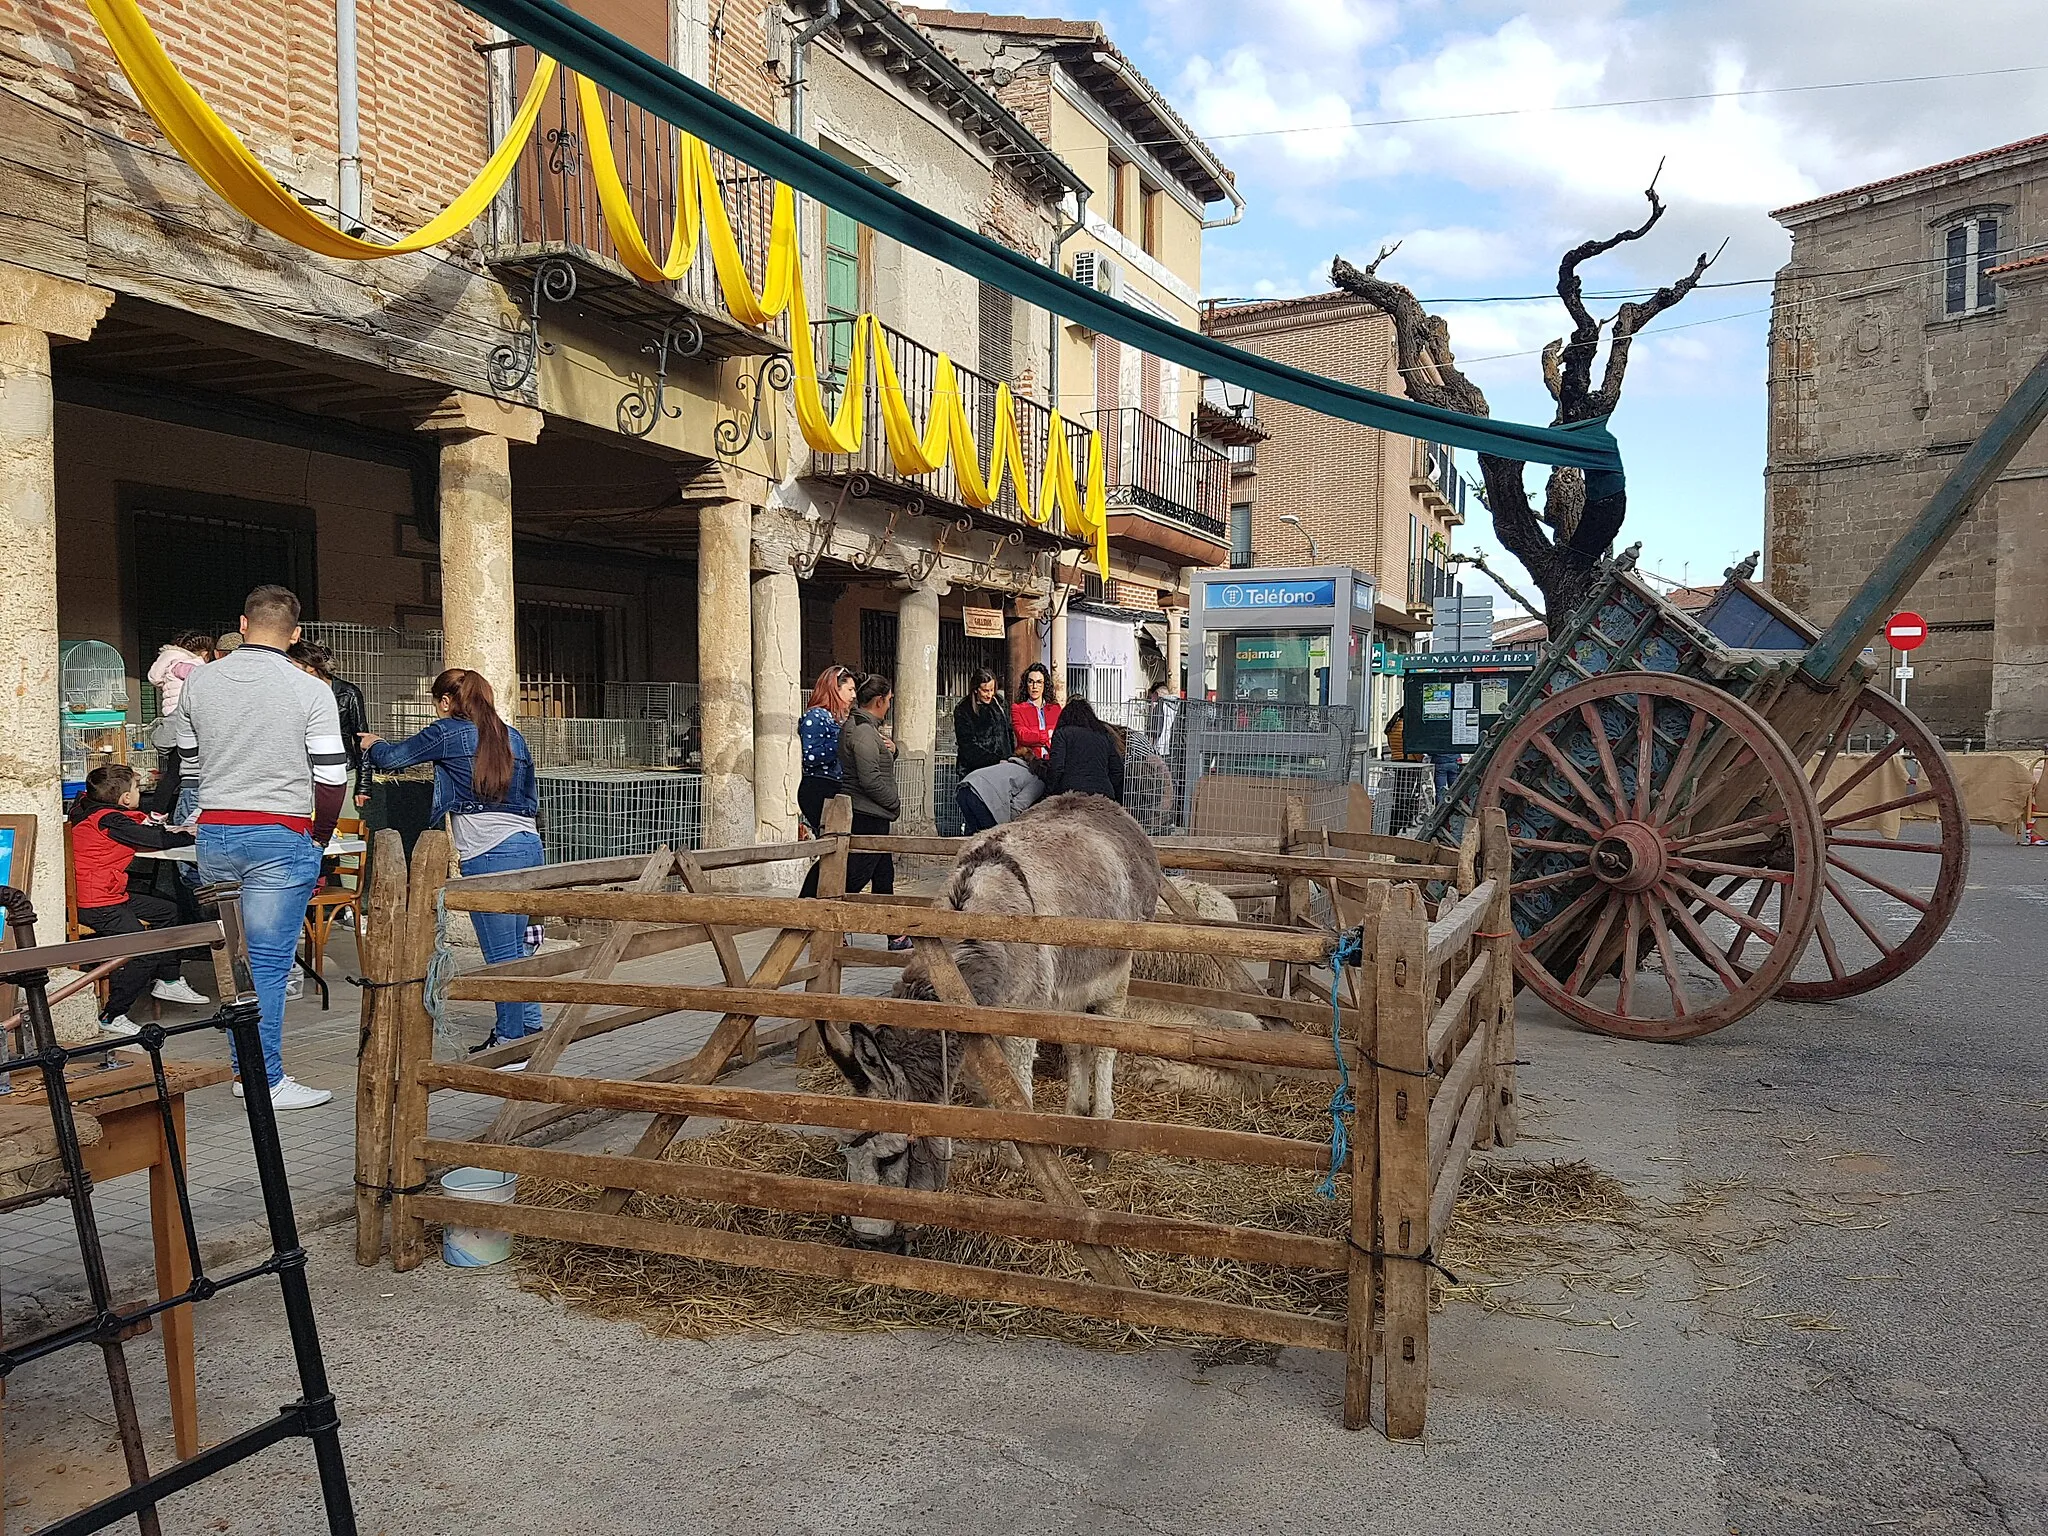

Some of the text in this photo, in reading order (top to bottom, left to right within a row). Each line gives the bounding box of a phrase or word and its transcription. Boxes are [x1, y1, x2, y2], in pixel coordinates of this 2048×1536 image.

[1246, 589, 1316, 604] Teléfono
[1236, 648, 1283, 663] cajamar
[1431, 655, 1468, 664] NAVA
[1472, 654, 1500, 663] DEL
[1503, 653, 1533, 662] REY
